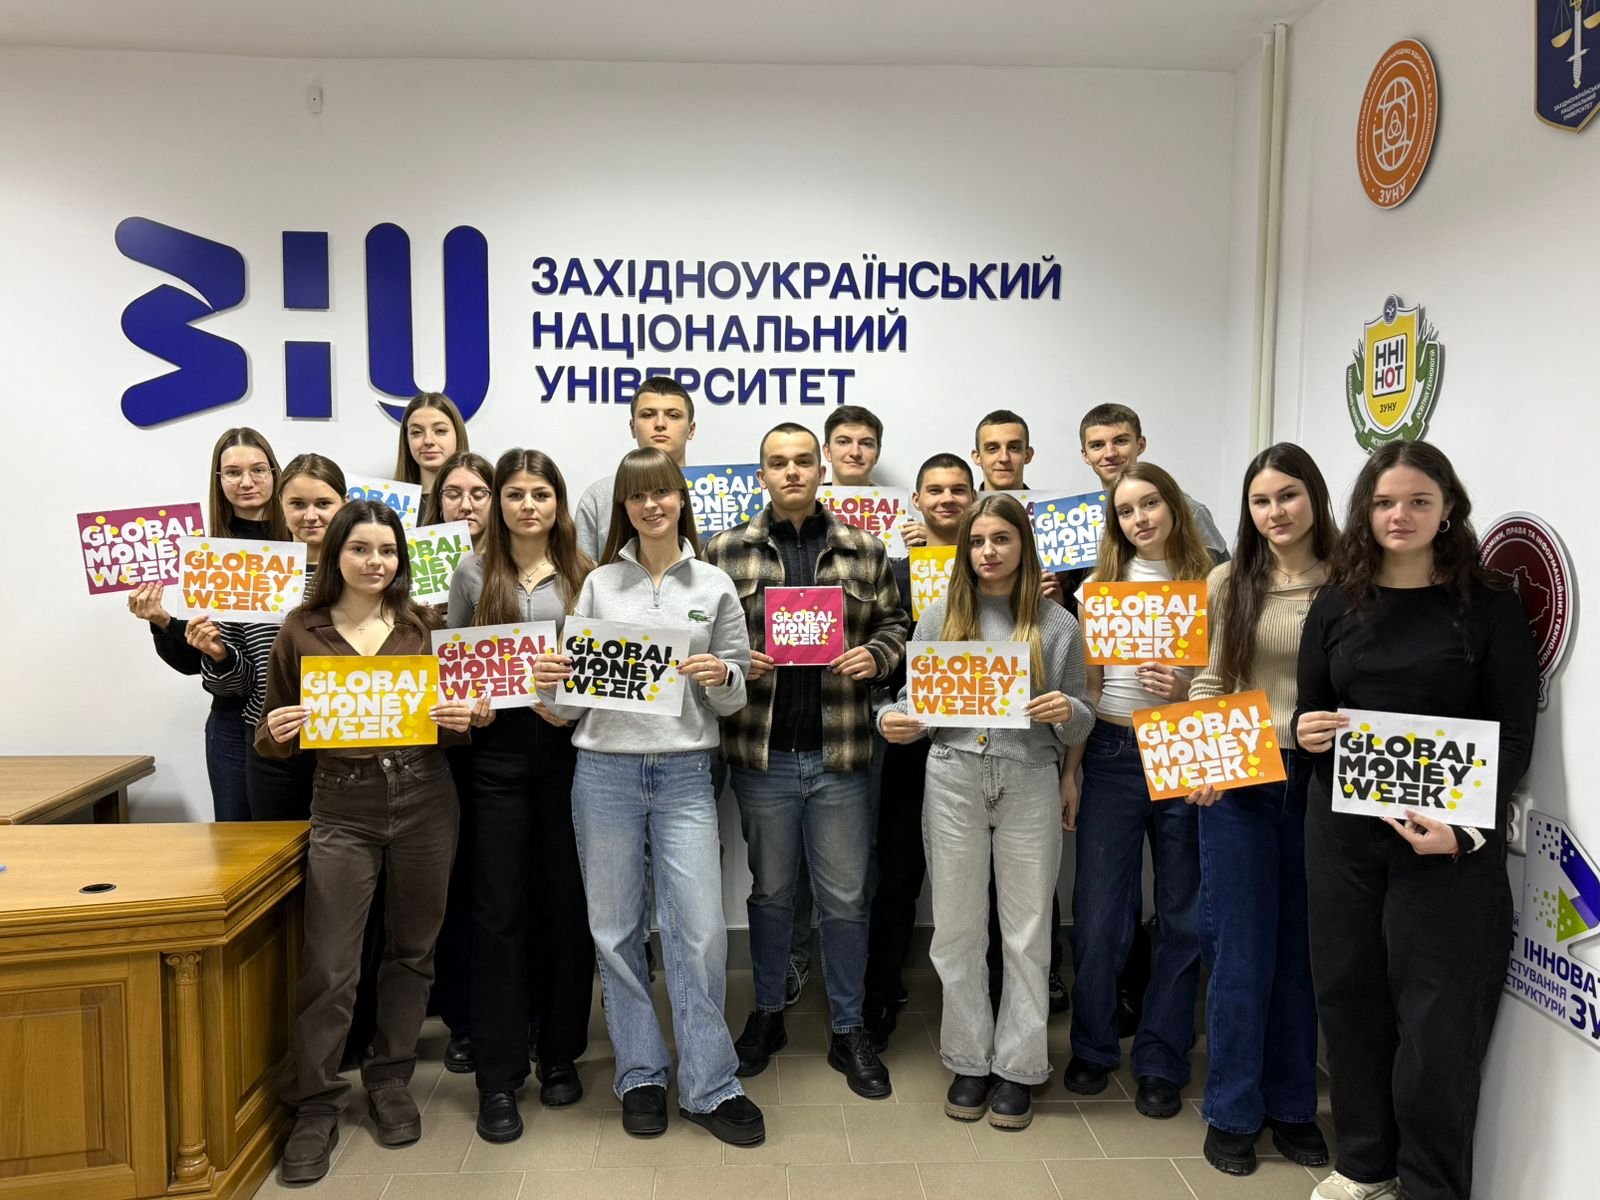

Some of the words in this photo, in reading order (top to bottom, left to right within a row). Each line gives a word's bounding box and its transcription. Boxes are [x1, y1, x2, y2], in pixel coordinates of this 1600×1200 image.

[1379, 179, 1407, 203] ЗУНУ
[531, 254, 1062, 304] ЗАХІДНОУКРАЇНСЬКИЙ
[532, 307, 908, 359] НАЦІОНАЛЬНИЙ
[1375, 338, 1405, 369] ННІ
[1374, 365, 1404, 391] НОТ
[1379, 401, 1398, 414] ЗУНУ
[348, 486, 416, 514] OBAL
[690, 493, 753, 514] ONEY
[694, 512, 739, 532] EEK
[1036, 504, 1104, 532] GLOB
[81, 515, 204, 548] GLOBAL
[84, 537, 181, 568] MONE
[184, 550, 303, 575] GLOBAL
[411, 552, 462, 578] NEY
[1038, 543, 1097, 568] WEE
[86, 557, 180, 589] WEEK
[184, 571, 292, 593] MONEY
[1505, 526, 1527, 536] ПРАВА
[1527, 529, 1536, 540] ТА
[1535, 535, 1564, 616] ІНФОРМАЦІЙНИХ
[411, 573, 450, 597] EK
[183, 589, 272, 612] WEEK
[1085, 594, 1206, 617] GLOBAL
[772, 610, 837, 623] GLOBAL
[772, 622, 831, 635] MONEY
[1086, 615, 1195, 637] MONEY
[437, 635, 555, 663] GLOBAL
[565, 635, 679, 665] GLOBAL
[772, 633, 821, 646] WEEK
[1085, 637, 1176, 659] WEEK
[569, 656, 668, 683] MONEY
[911, 655, 1028, 676] GLOBAL
[303, 669, 437, 694] GLOBAL
[439, 675, 529, 701] WEEK
[563, 674, 648, 701] WEEK
[911, 675, 1017, 696] MONEY
[303, 691, 426, 717] MONEY
[911, 694, 998, 716] WEEK
[305, 714, 405, 741] WEEK
[1138, 705, 1272, 746] GLOBAL
[1141, 728, 1261, 770] MONEY
[1339, 731, 1487, 767] GLOBAL
[1146, 754, 1249, 792] WEEK
[1338, 754, 1472, 787] MONEY
[1337, 775, 1447, 809] WEEK
[1509, 958, 1567, 1001] СТУВАННЯ
[1524, 936, 1600, 999] ІННОВА
[1505, 972, 1567, 1020] СТРУКТУРИ
